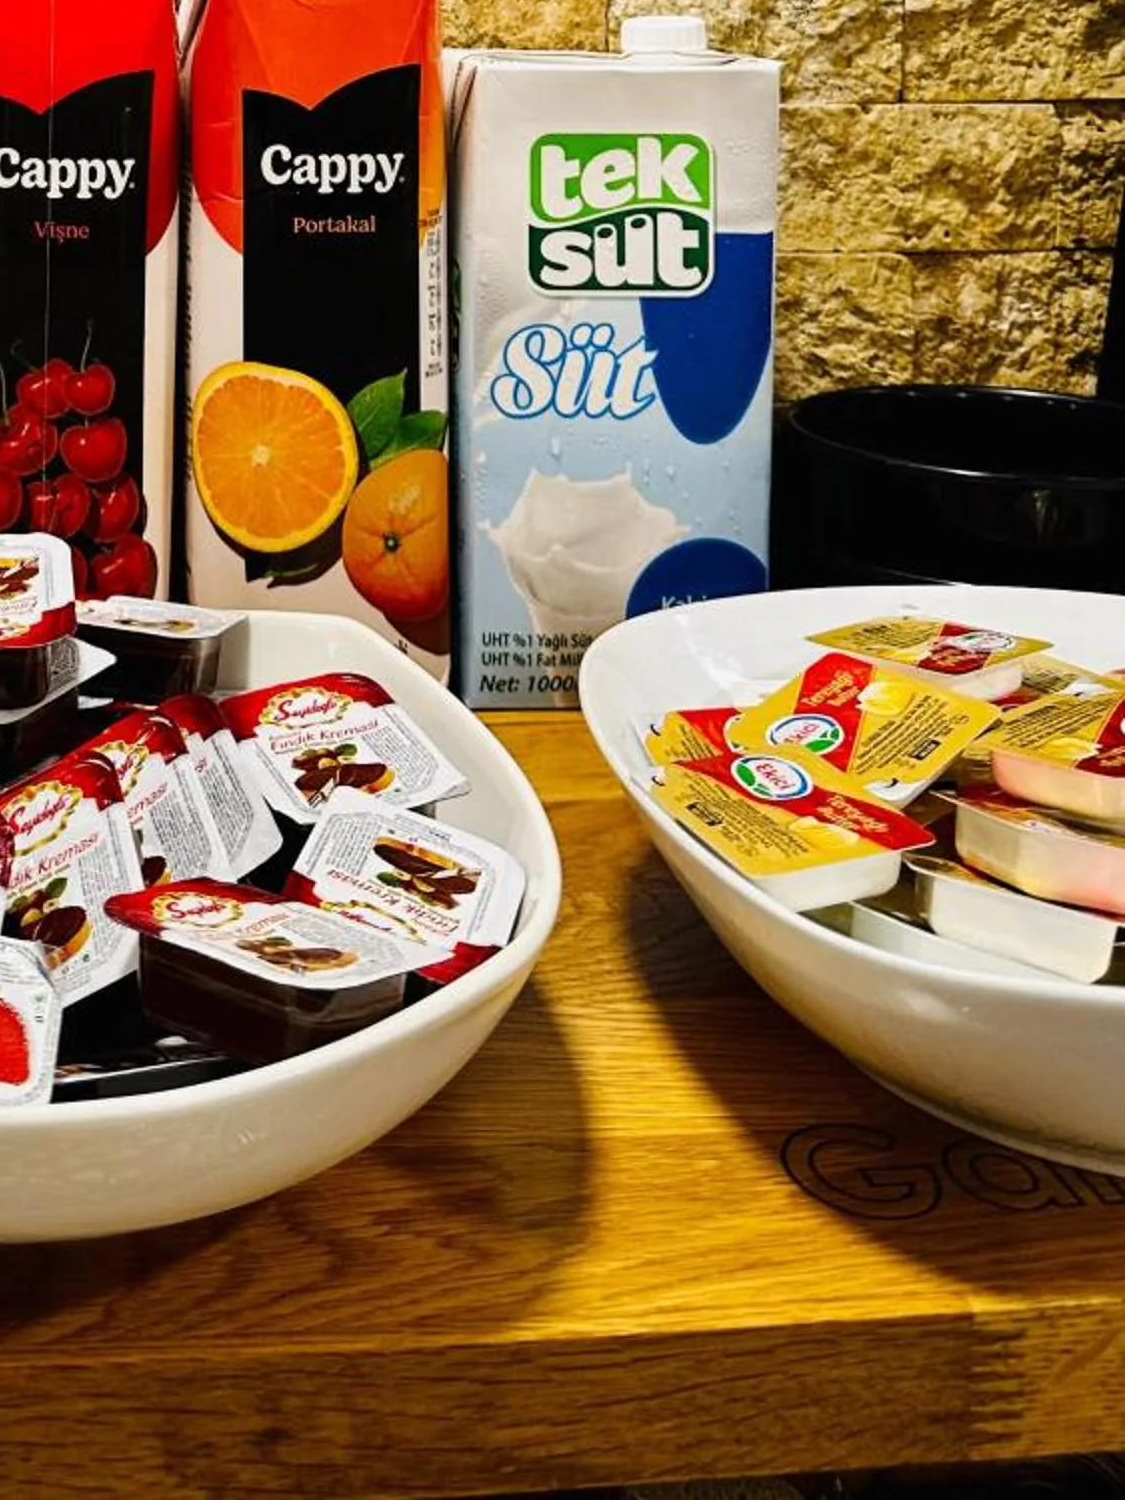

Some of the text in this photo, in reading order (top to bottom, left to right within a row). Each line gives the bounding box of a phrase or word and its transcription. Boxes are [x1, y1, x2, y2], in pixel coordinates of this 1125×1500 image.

[260, 144, 403, 194] Cappy
[540, 136, 703, 219] tek
[33, 220, 90, 244] Vişne
[292, 215, 376, 235] Portakal
[539, 212, 702, 288] süt
[490, 322, 660, 420] Süt
[481, 631, 510, 647] UHT
[513, 632, 532, 648] %1
[481, 651, 510, 667] UHT
[512, 652, 532, 668] %1
[536, 652, 557, 668] Fat
[479, 674, 520, 693] Net:
[754, 761, 797, 791] Ekici
